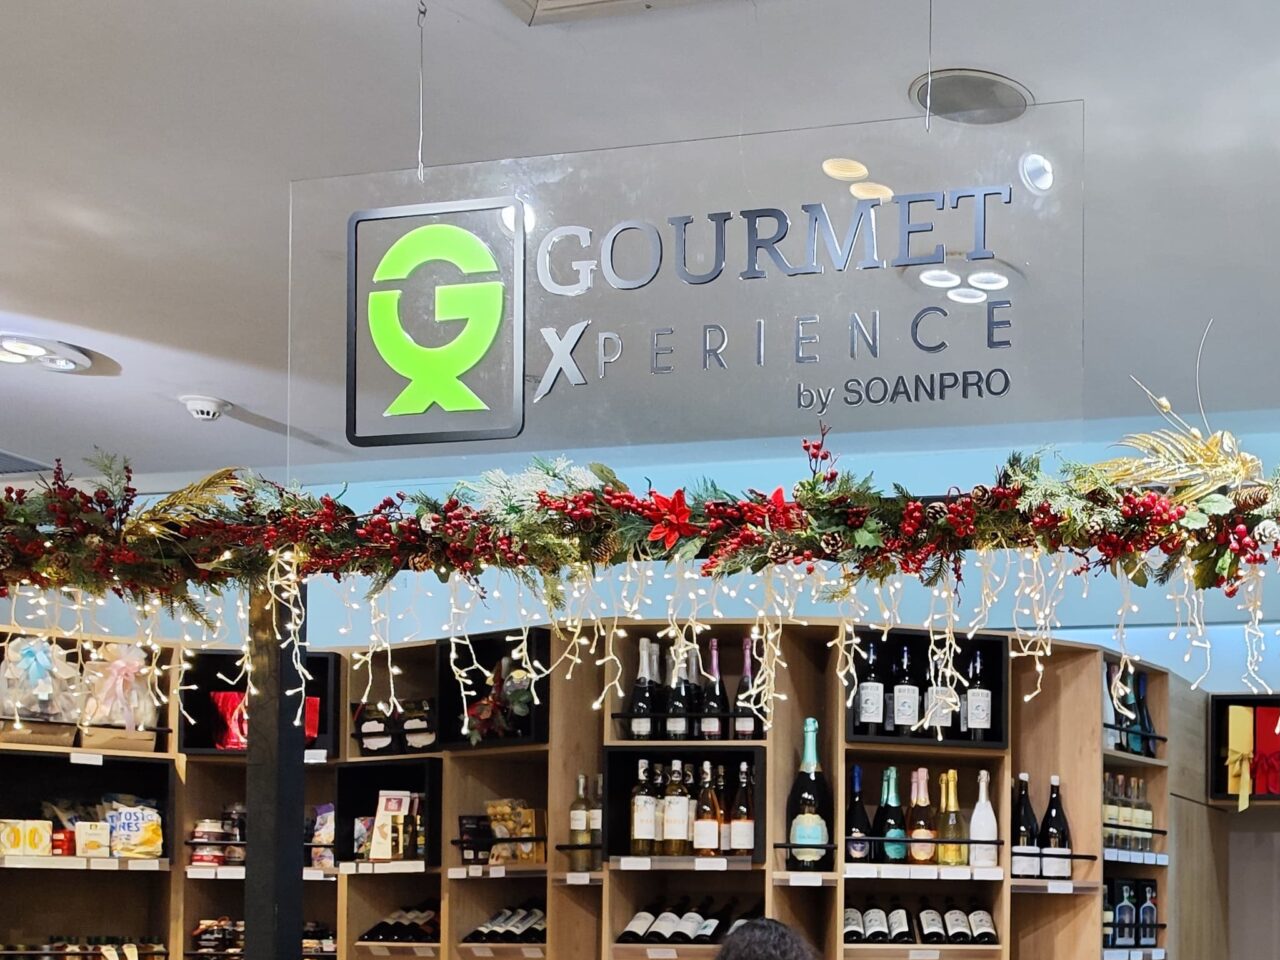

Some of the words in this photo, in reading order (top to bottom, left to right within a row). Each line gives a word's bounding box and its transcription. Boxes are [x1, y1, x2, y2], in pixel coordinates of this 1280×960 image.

[537, 186, 1011, 296] GOURMET
[535, 300, 1011, 403] XPERIENCE
[797, 383, 834, 412] by
[843, 368, 1010, 406] SOANPRO
